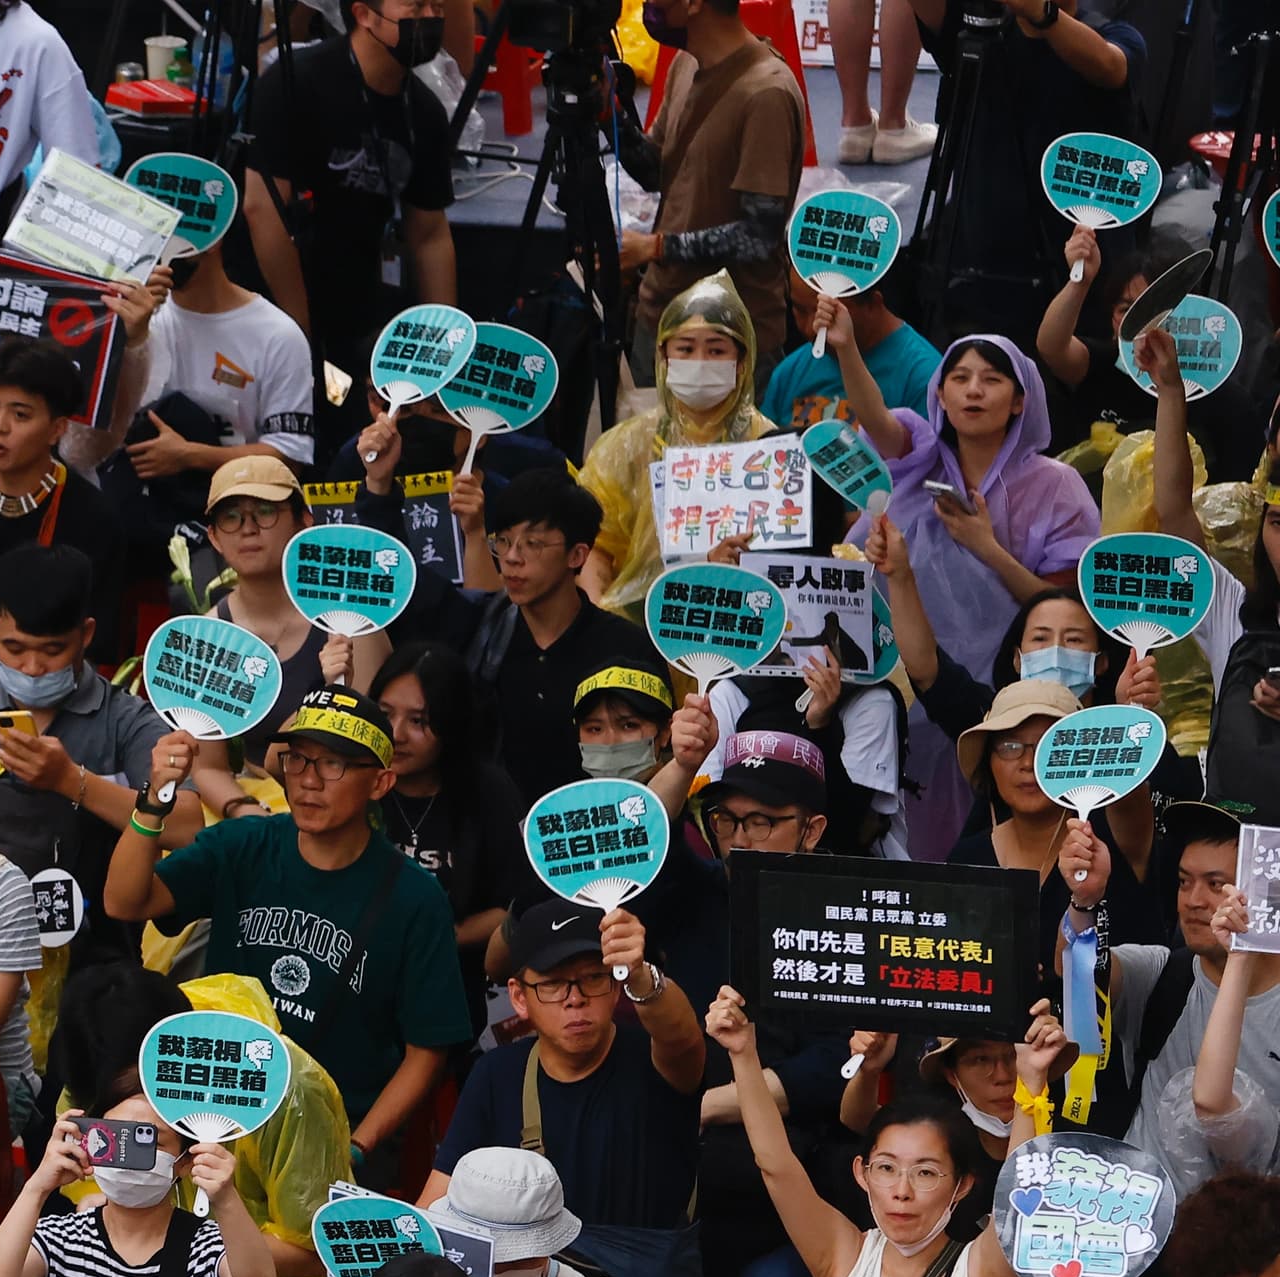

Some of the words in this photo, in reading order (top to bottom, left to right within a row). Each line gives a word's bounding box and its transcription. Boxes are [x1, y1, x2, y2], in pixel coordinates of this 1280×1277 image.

[670, 447, 807, 495] 守護台灣
[666, 500, 808, 550] 捍衛民主
[298, 543, 372, 569] 我藐視
[1093, 551, 1169, 577] 我藐視
[296, 566, 395, 594] 藍白黑箱
[664, 581, 742, 610] 我藐視
[1092, 574, 1195, 602] 藍白黑箱
[660, 605, 765, 637] 藍白黑箱
[165, 629, 239, 673] 我藐視
[157, 651, 257, 705] 藍白黑箱
[536, 806, 619, 835] 我藐視
[541, 827, 649, 862] 藍白黑箱
[825, 905, 869, 922] 國民黨
[871, 908, 915, 925] 民眾黨
[917, 911, 947, 927] 立委
[772, 927, 866, 955] 你們先是
[877, 934, 993, 964] 「民意代表」
[772, 957, 866, 986] 然後才是
[877, 965, 993, 994] 「立法委員」
[158, 1034, 242, 1063] 我藐視
[156, 1060, 268, 1093] 藍白黑箱
[1016, 1149, 1161, 1227] 我藐視
[1019, 1215, 1129, 1277] 國會
